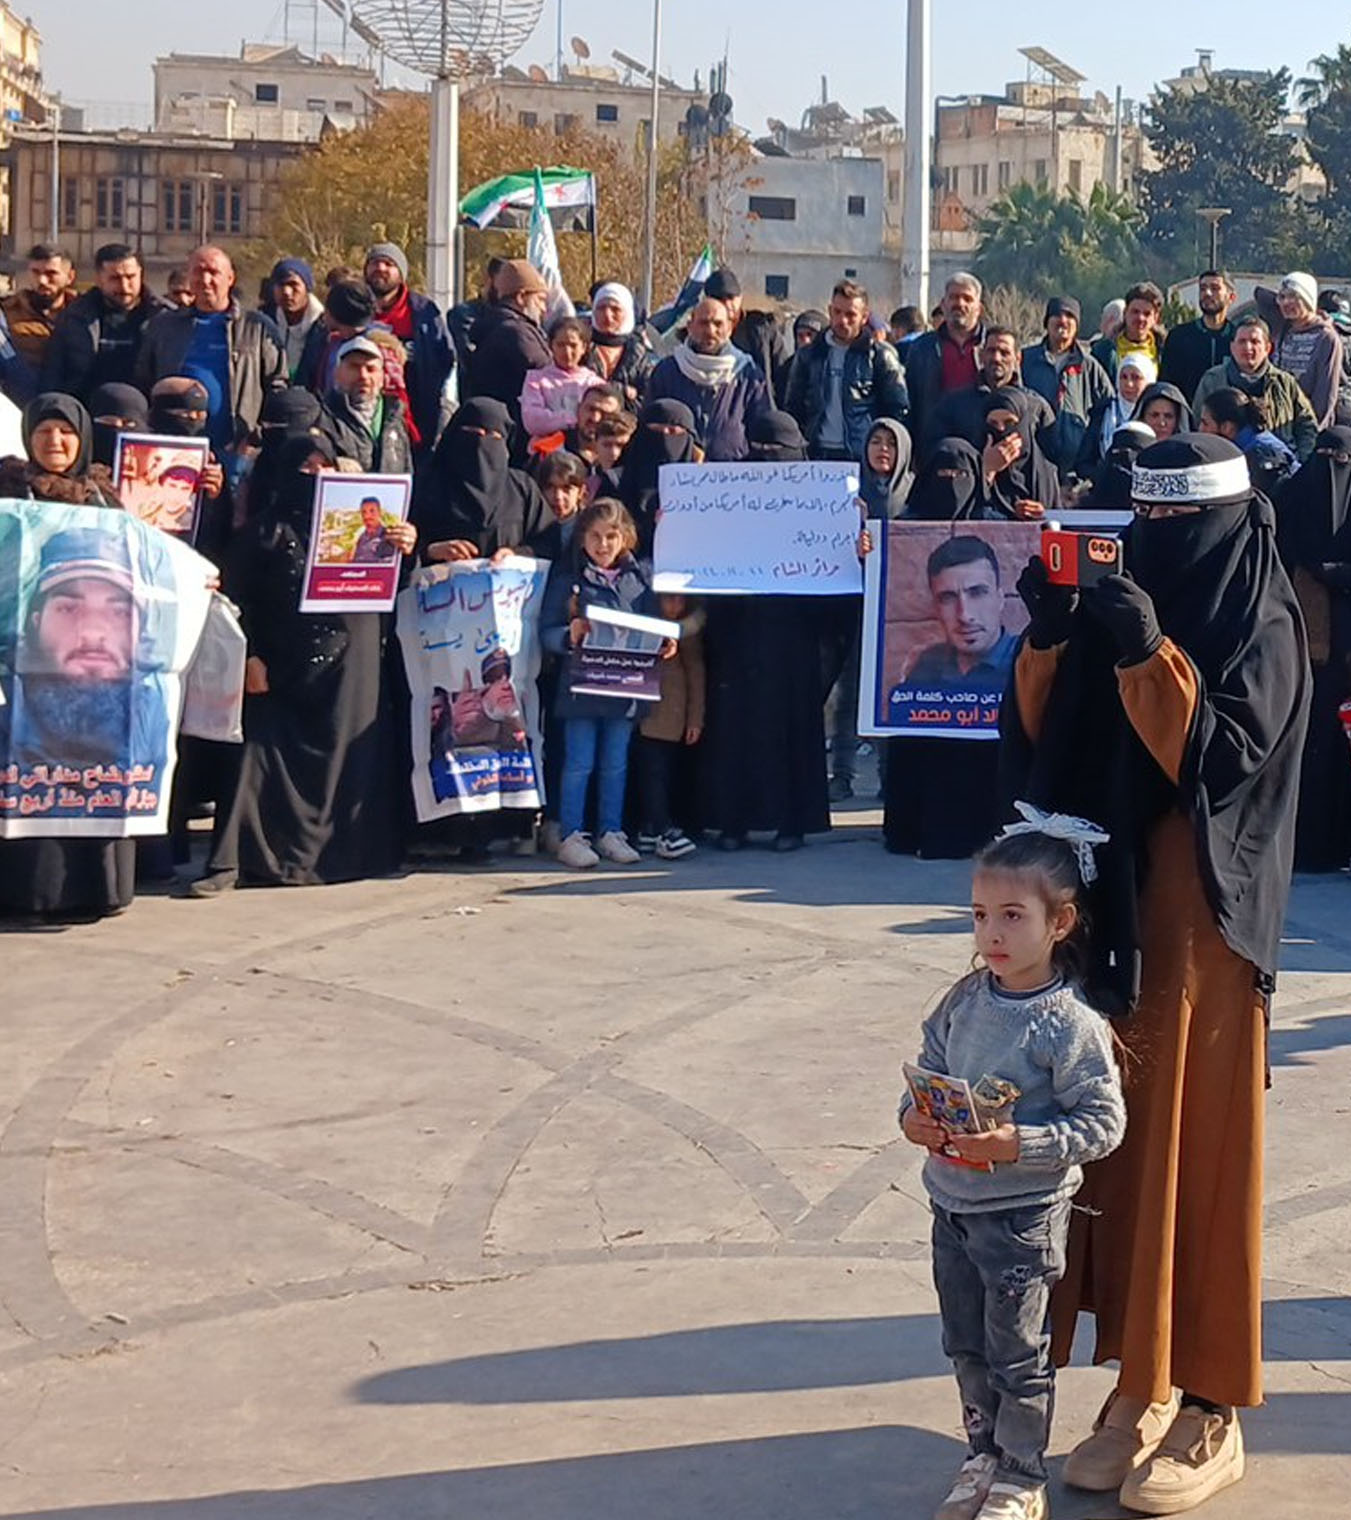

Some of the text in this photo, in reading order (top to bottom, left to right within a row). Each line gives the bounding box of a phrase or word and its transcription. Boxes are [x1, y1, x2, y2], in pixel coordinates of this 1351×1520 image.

[782, 464, 814, 483] أمريكا
[715, 492, 746, 512] أمريكا
[891, 690, 914, 703] الحق
[915, 690, 944, 703] كلمة
[945, 691, 978, 704] صاحب
[980, 692, 996, 704] عن
[908, 705, 999, 726] الد أبو محمد
